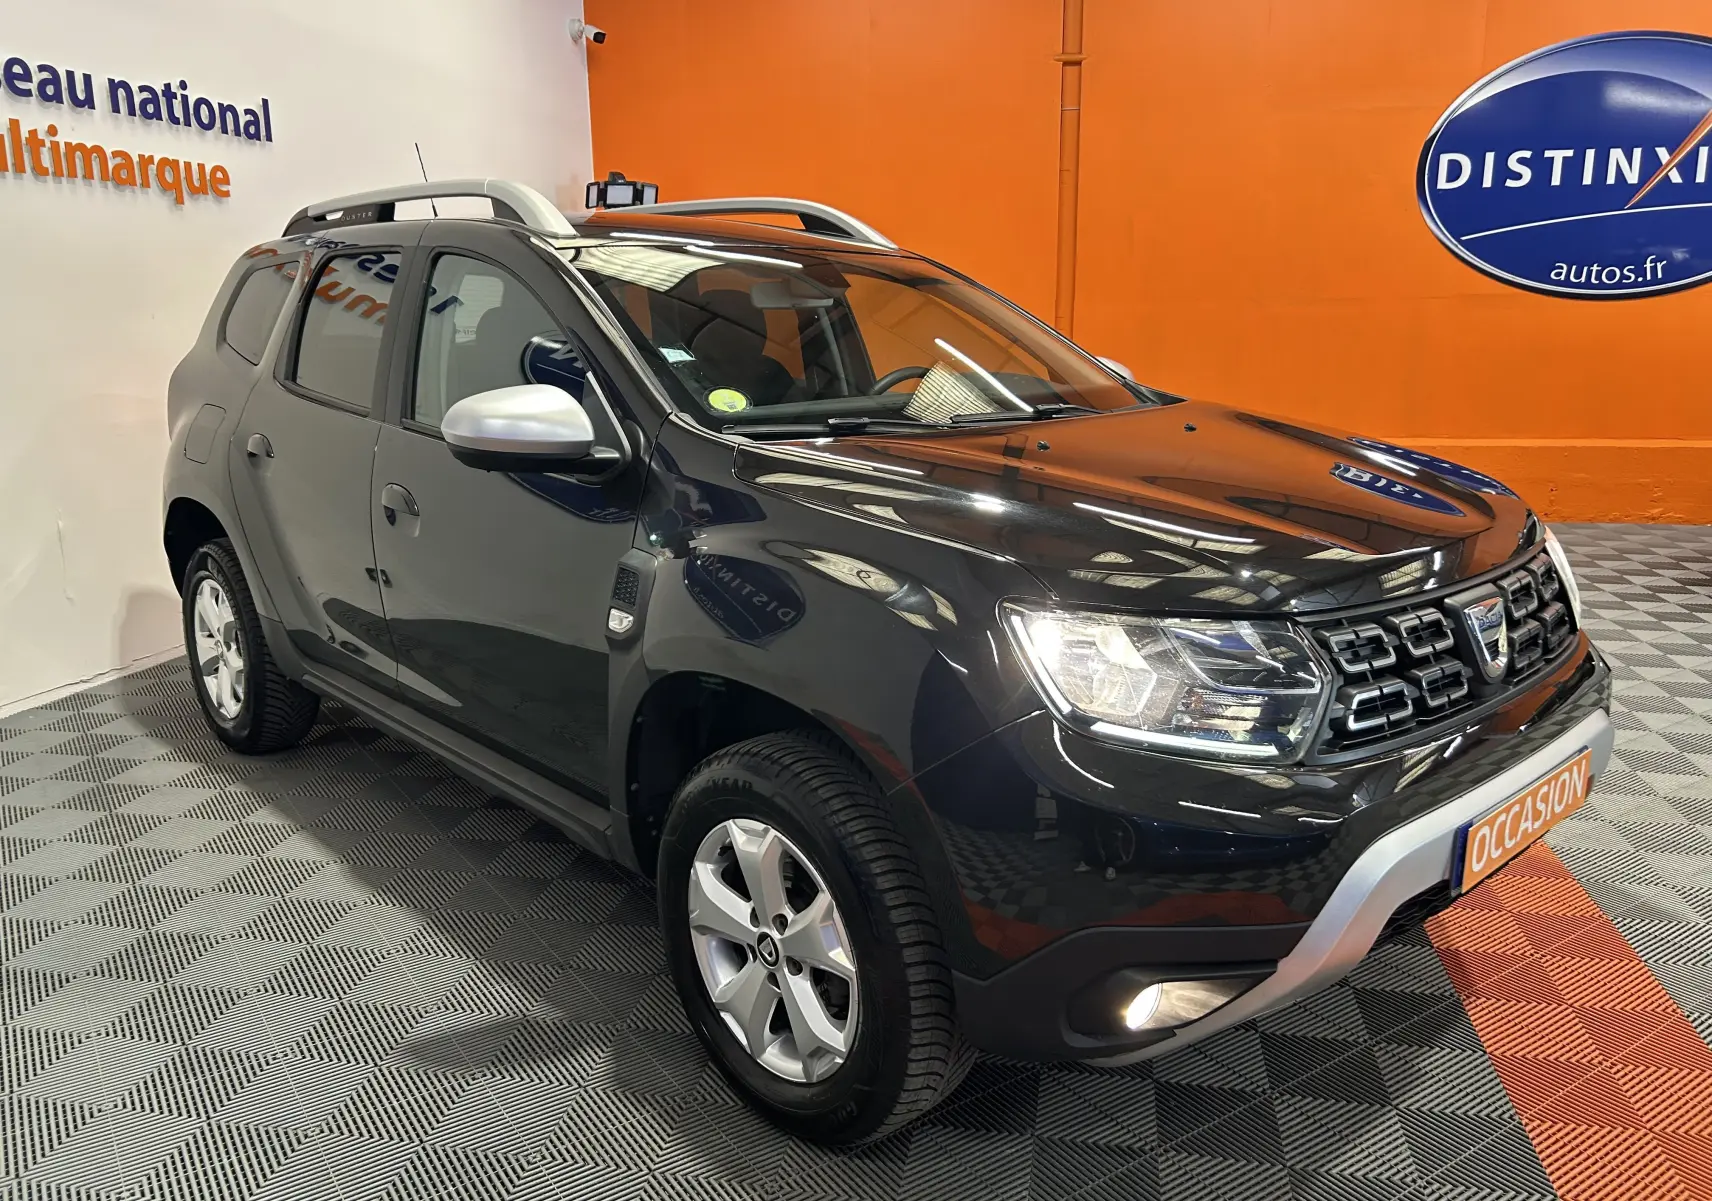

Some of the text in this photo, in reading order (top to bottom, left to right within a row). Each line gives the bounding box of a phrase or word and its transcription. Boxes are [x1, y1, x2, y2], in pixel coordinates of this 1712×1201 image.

[0, 56, 273, 143] eau national
[1550, 255, 1667, 284] autos.fr
[1472, 759, 1586, 873] OCCASION
